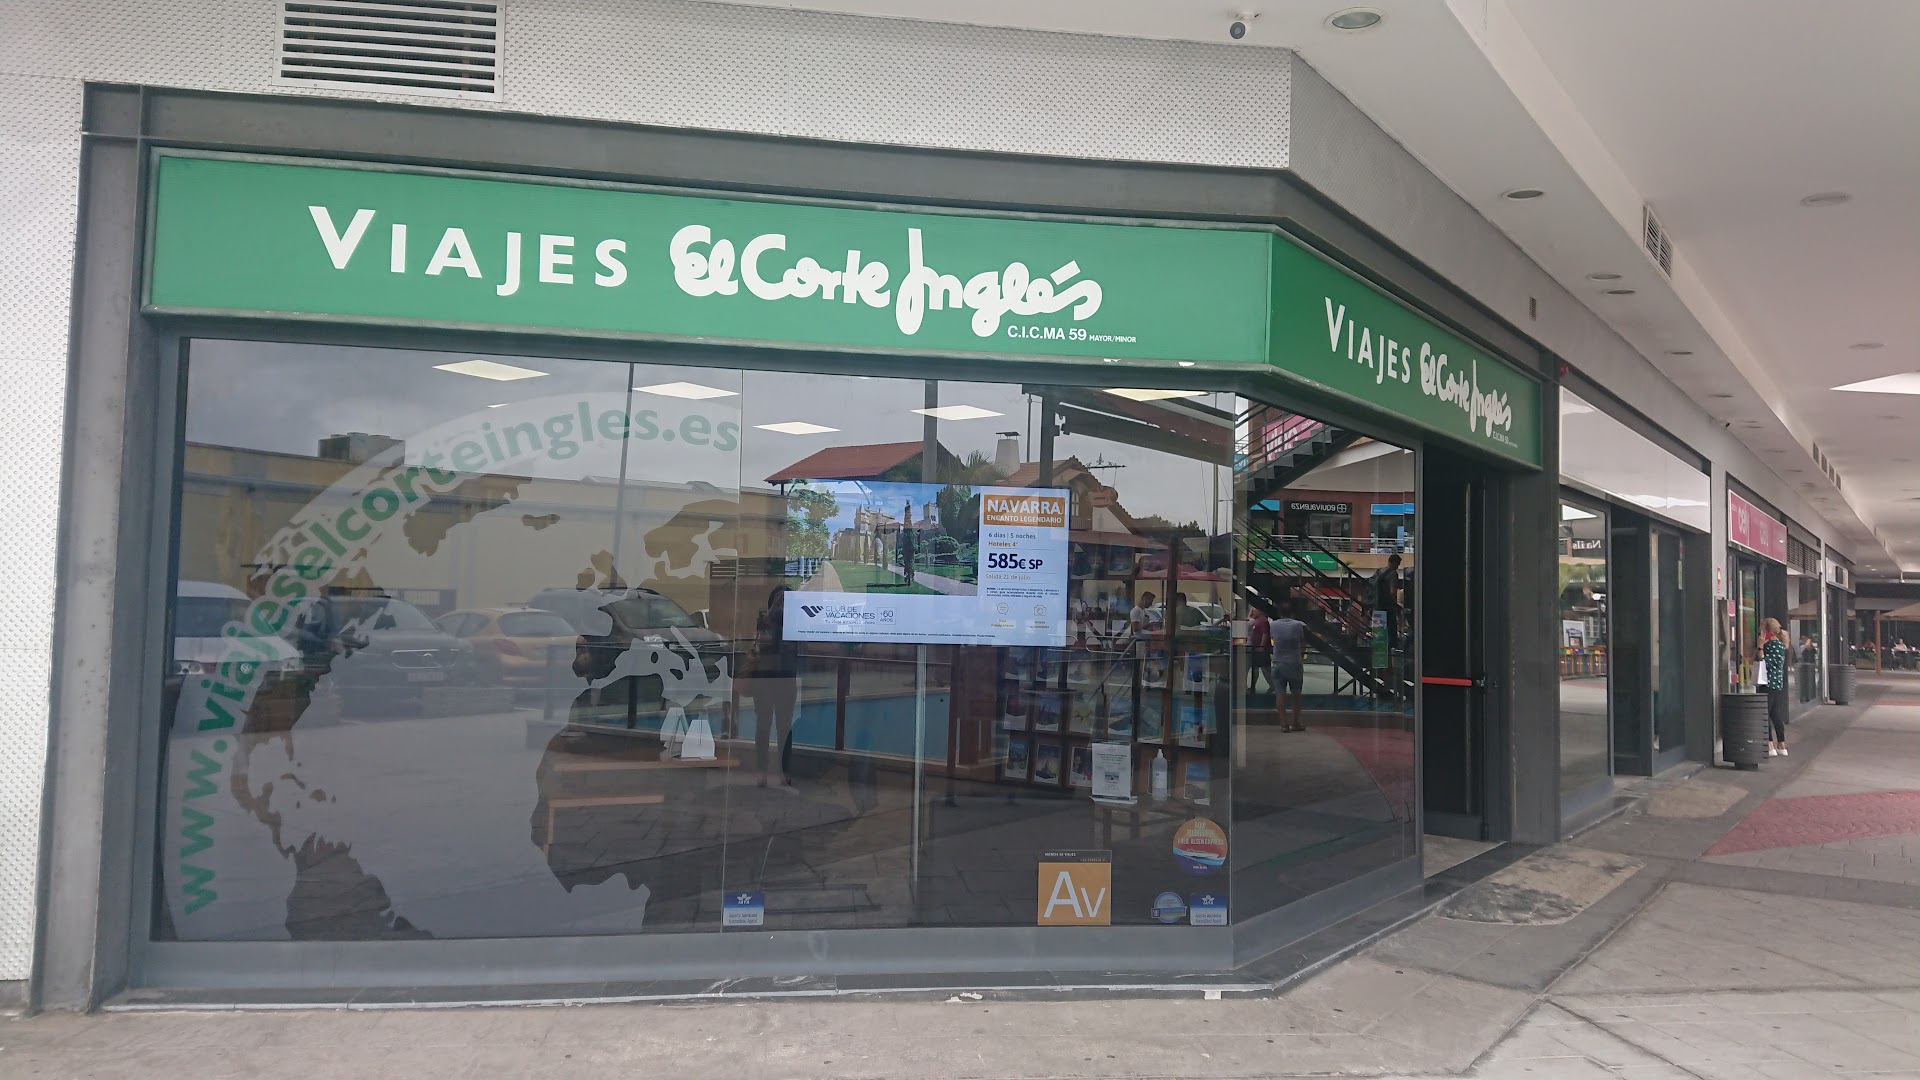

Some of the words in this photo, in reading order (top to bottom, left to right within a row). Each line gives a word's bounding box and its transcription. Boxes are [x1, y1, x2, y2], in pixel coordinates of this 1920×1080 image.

[308, 204, 628, 297] VIAJES
[669, 224, 739, 297] El
[740, 233, 891, 308] Corte
[895, 227, 1103, 338] Inglés
[1068, 328, 1087, 341] 59
[1324, 296, 1411, 385] VIAJES
[1420, 341, 1437, 396] El
[1436, 353, 1470, 413] Corte
[1469, 358, 1512, 438] Inglés
[987, 498, 1062, 515] NAVARRA
[986, 514, 1019, 522] ENCANTO
[1020, 515, 1062, 524] LEGENDARIO
[987, 552, 1027, 569] 585€
[1028, 558, 1044, 570] SP
[825, 605, 846, 613] CLUB
[847, 605, 858, 613] DE
[825, 612, 876, 620] VACACIONES
[180, 401, 740, 915] www.viajeselcorteingles.es
